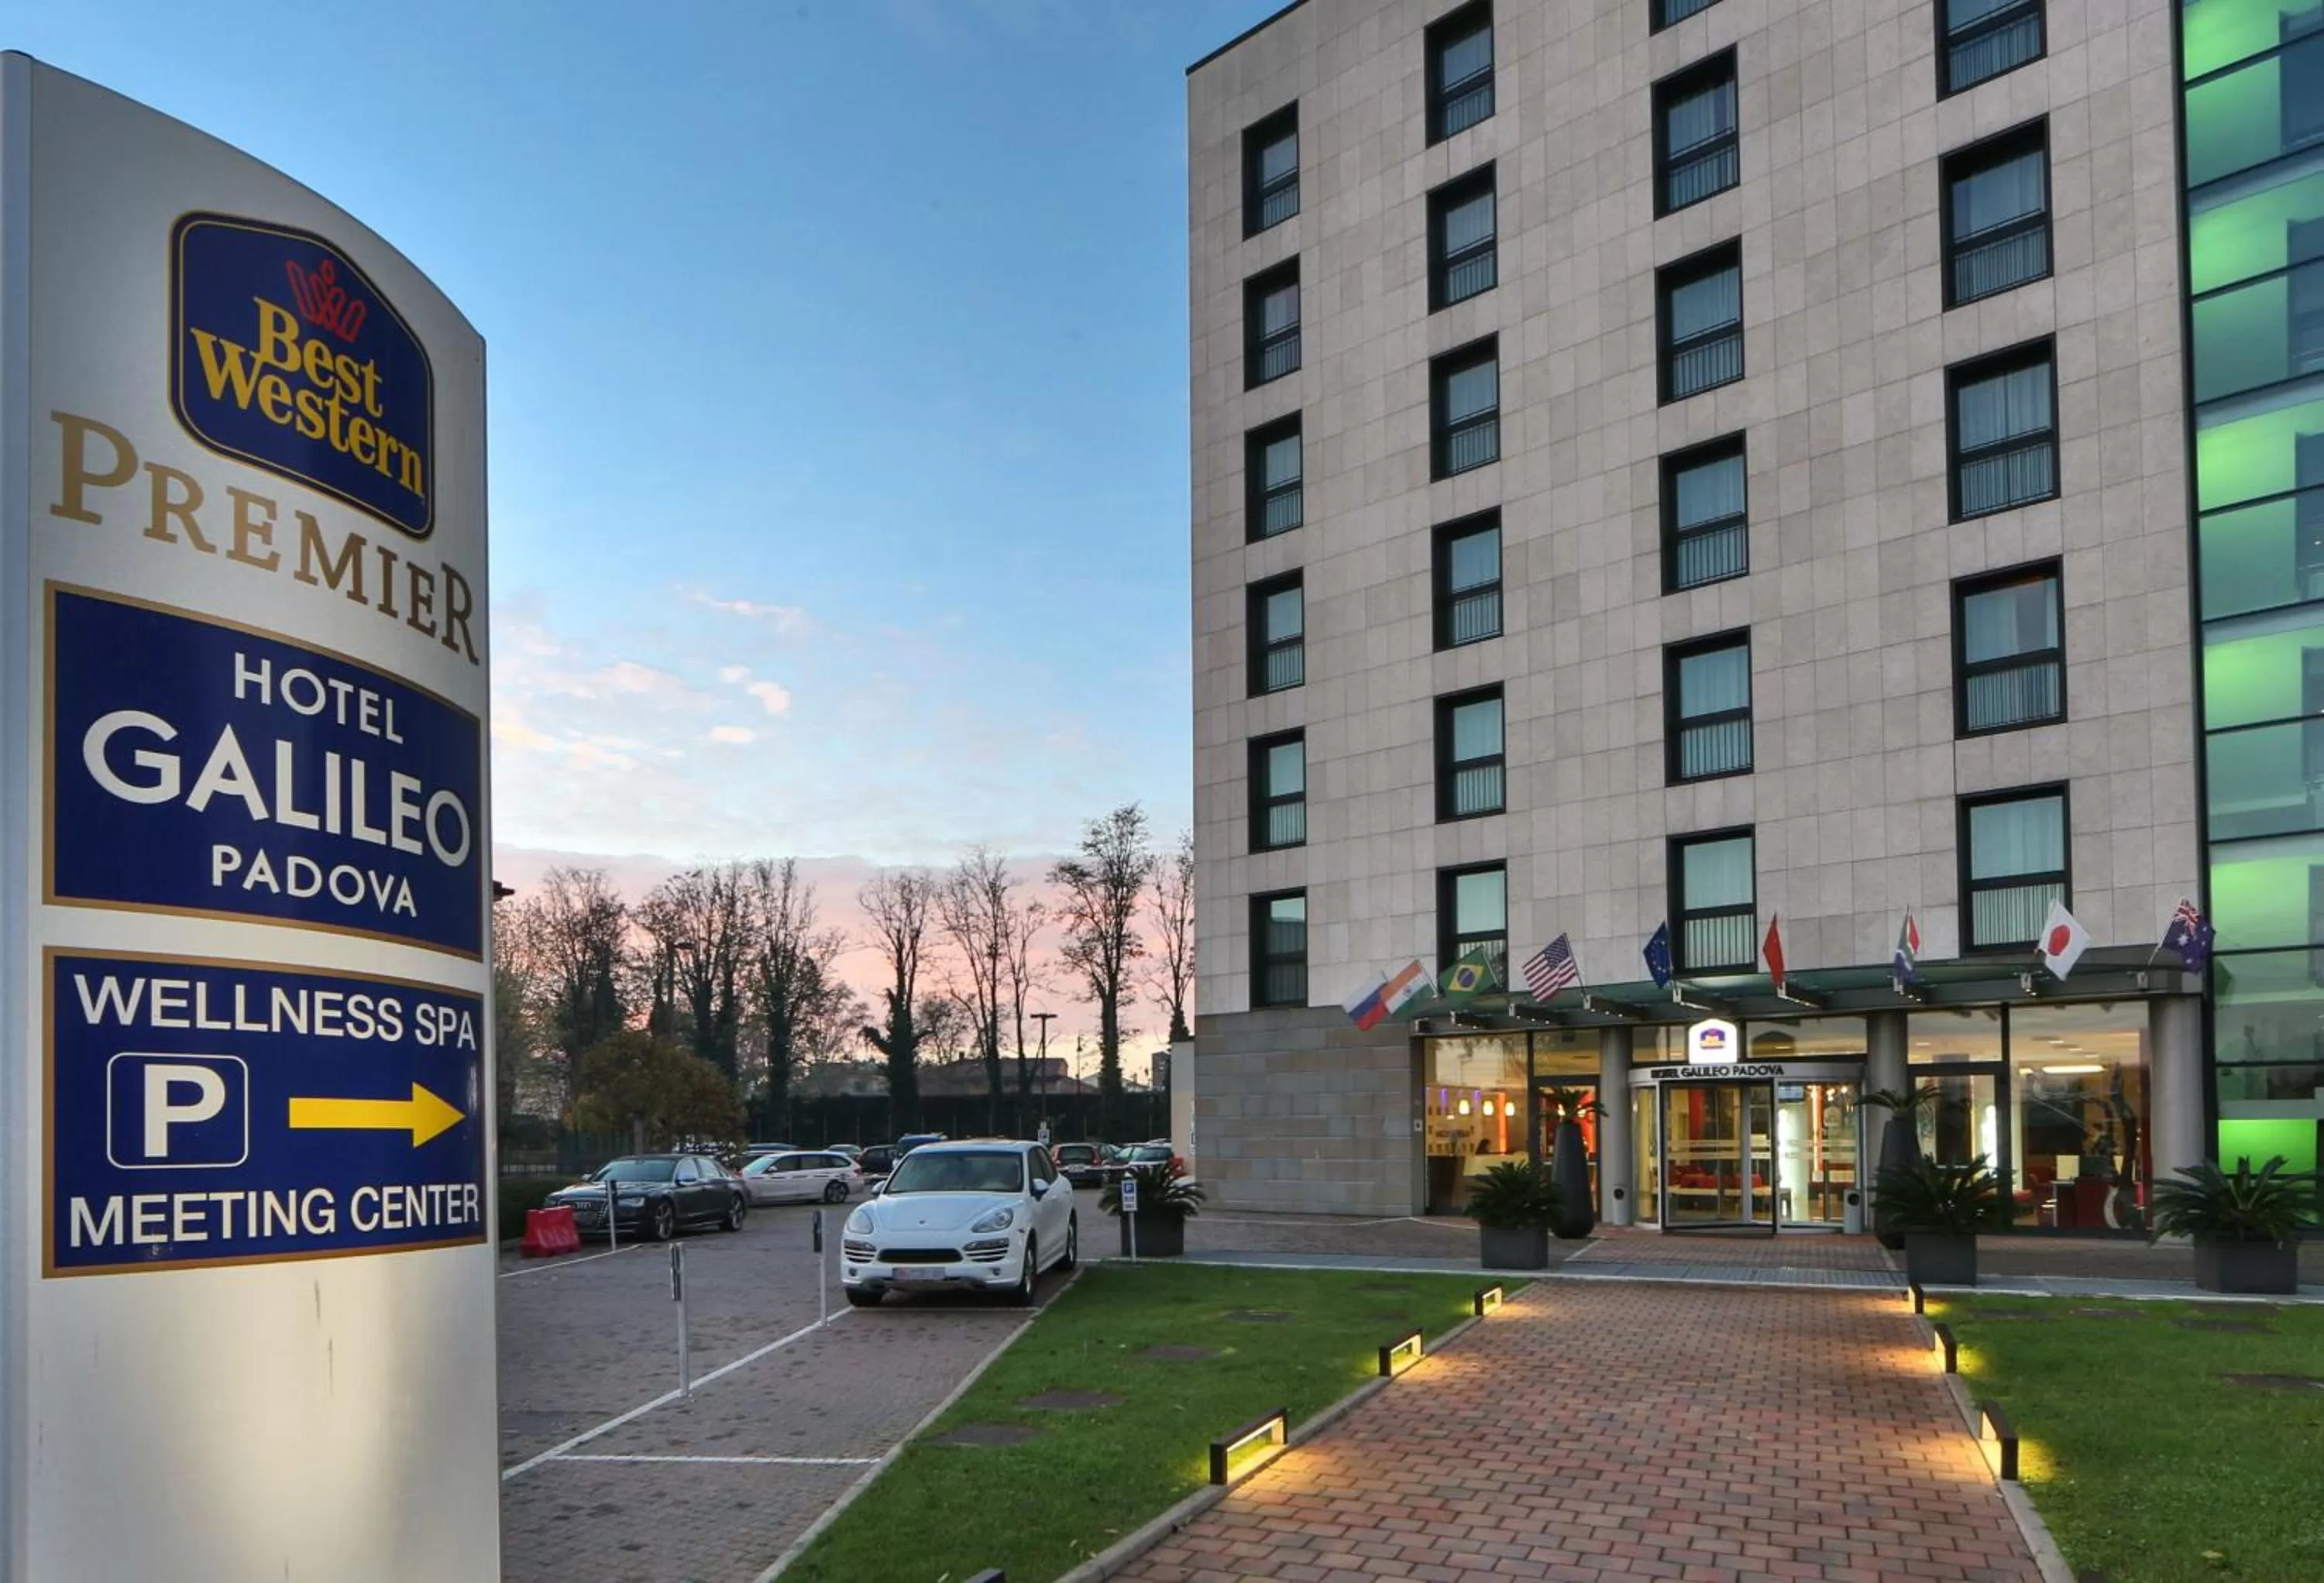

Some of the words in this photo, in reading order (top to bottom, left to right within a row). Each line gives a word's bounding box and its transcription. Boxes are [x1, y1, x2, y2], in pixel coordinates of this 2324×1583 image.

[253, 297, 383, 417] Best
[191, 327, 425, 498] Western
[50, 410, 480, 666] PREMIER
[235, 652, 404, 744] HOTEL
[83, 709, 471, 868] GALILEO
[212, 844, 418, 919] PADOVA
[74, 973, 404, 1042] WELLNESS
[415, 1002, 477, 1051] SPA
[143, 1063, 226, 1158] P
[1732, 1064, 1785, 1076] PADOVA
[70, 1187, 335, 1248] MEETING
[351, 1183, 480, 1230] CENTER
